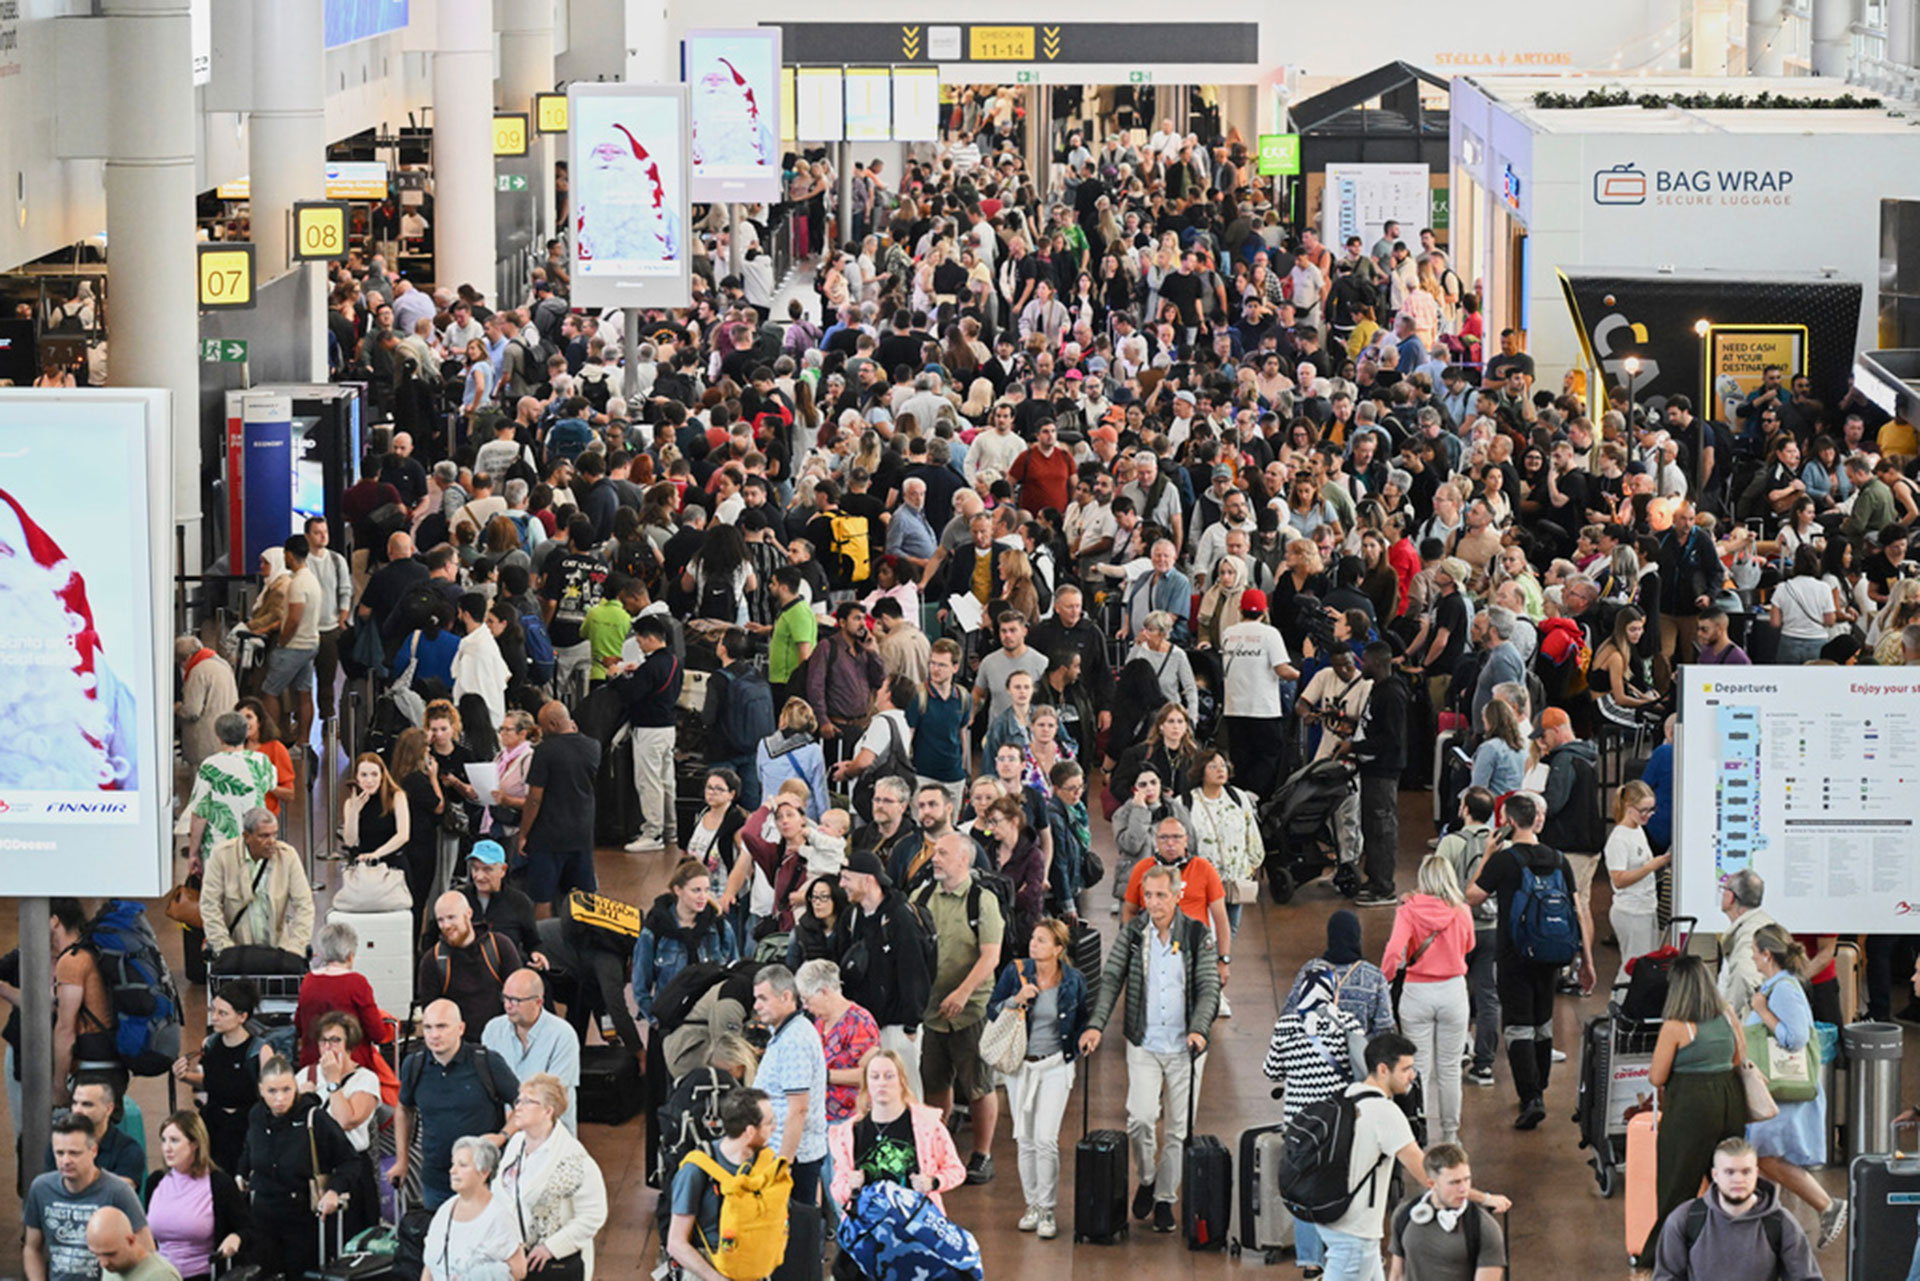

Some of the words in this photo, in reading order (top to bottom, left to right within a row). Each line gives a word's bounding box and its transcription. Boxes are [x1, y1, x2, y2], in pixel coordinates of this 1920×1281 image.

[982, 44, 1024, 56] 11-14
[1435, 52, 1493, 65] STELLA
[1512, 52, 1572, 65] ARTOIS
[497, 131, 521, 149] 09
[1657, 170, 1711, 192] BAG
[1717, 170, 1793, 192] WRAP
[1656, 195, 1713, 205] SECURE
[1720, 195, 1792, 205] LUGGAGE
[306, 224, 337, 248] 08
[208, 271, 242, 296] 07
[48, 346, 56, 357] 7
[66, 346, 73, 357] 1
[1722, 343, 1748, 352] NEED
[1750, 343, 1776, 352] CASH
[1722, 353, 1734, 362] AT
[1736, 353, 1762, 362] YOUR
[1715, 683, 1778, 694] Departures
[1850, 683, 1880, 695] Enjoy
[1883, 685, 1908, 695] your
[46, 803, 128, 814] FINNAIR
